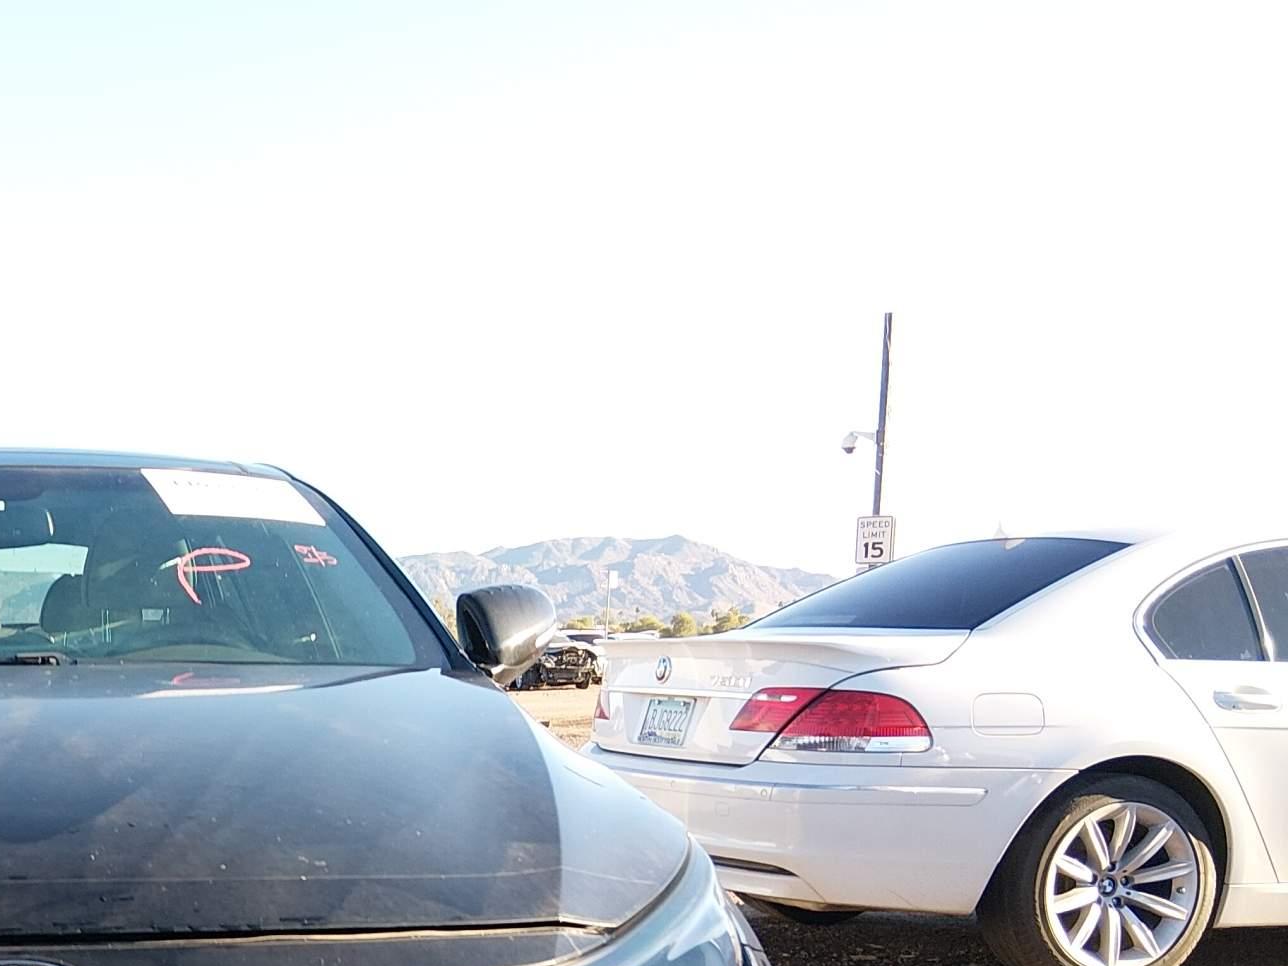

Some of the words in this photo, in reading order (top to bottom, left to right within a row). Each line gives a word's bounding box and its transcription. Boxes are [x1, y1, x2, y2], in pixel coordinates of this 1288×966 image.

[860, 520, 890, 528] SPEED
[862, 530, 886, 539] LIMIT
[863, 541, 884, 559] 15
